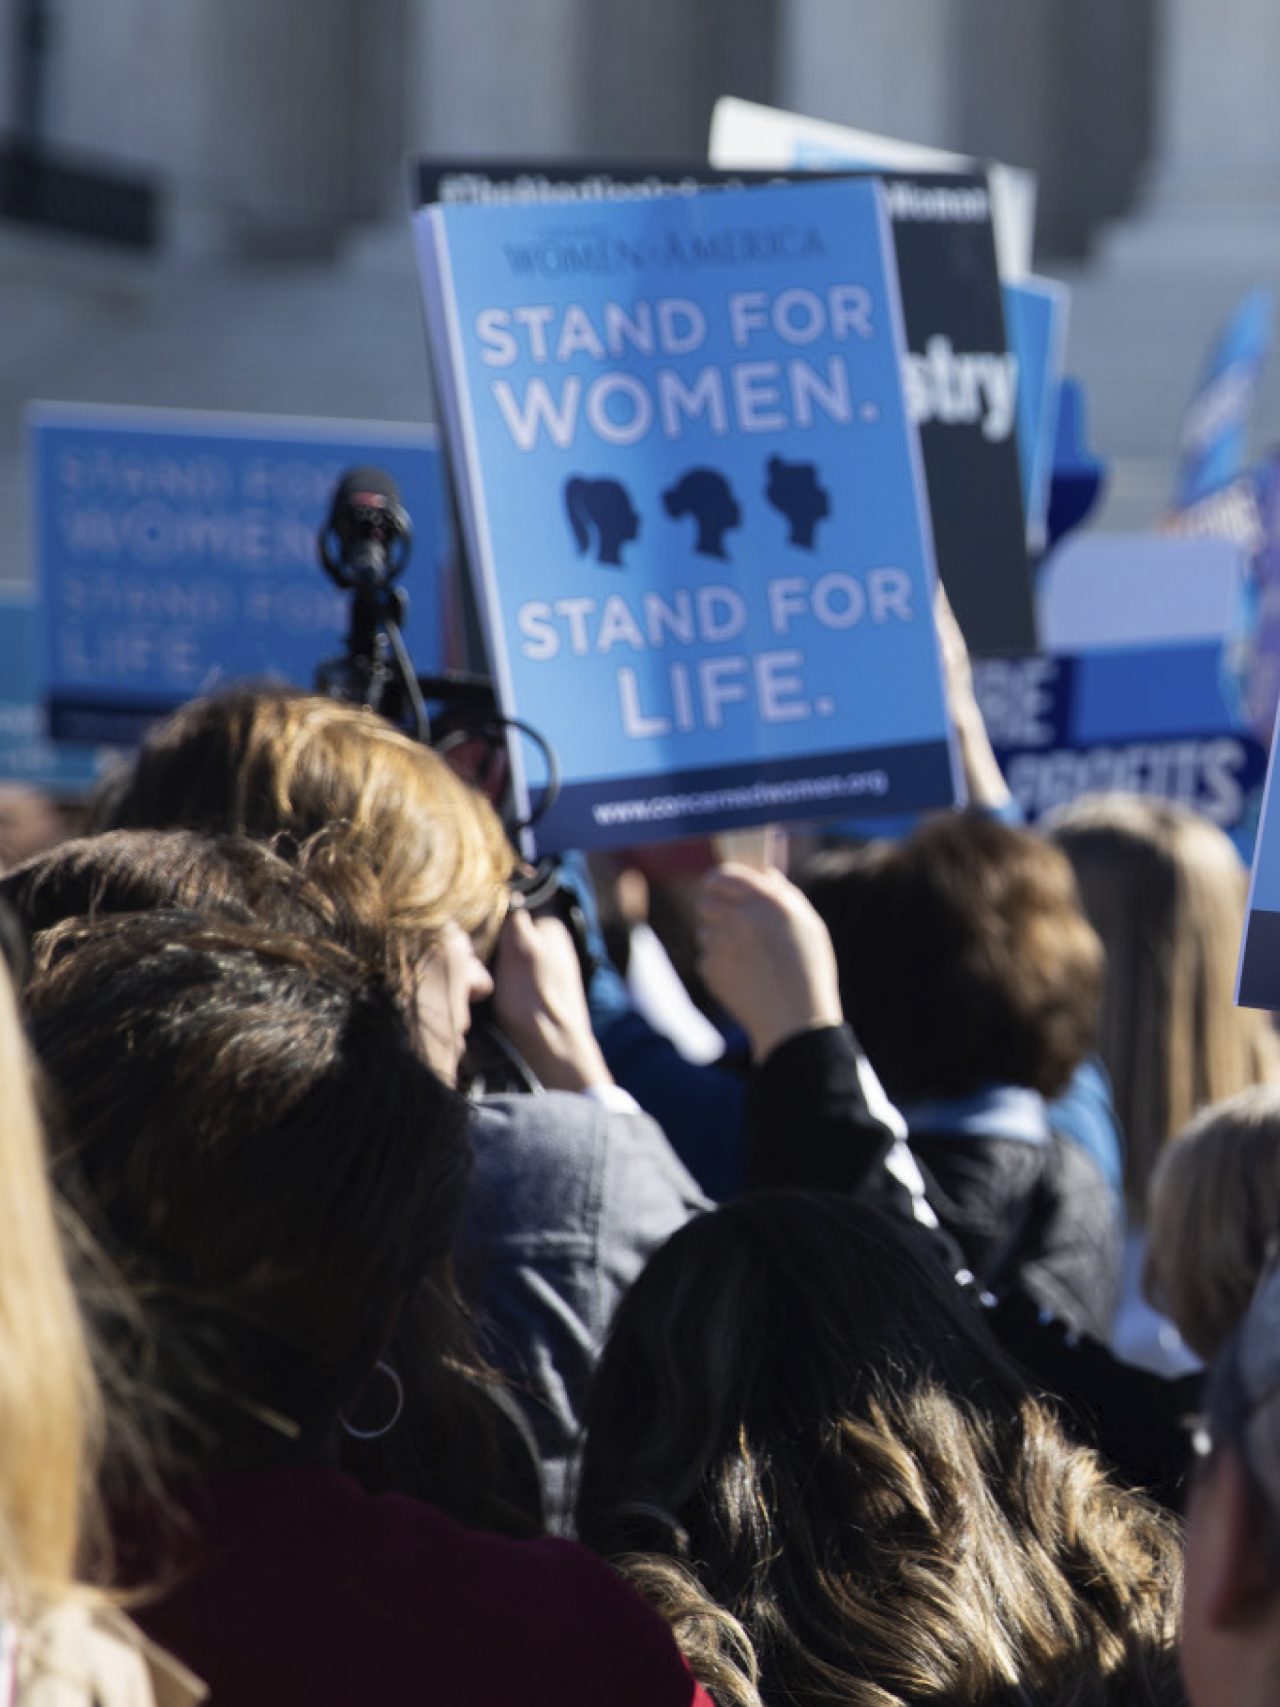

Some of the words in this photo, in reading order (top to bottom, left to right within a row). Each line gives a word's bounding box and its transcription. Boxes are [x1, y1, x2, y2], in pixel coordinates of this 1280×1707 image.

[503, 237, 645, 279] WOMEN
[665, 223, 828, 269] AMERICA
[475, 299, 703, 366] STAND
[728, 284, 875, 350] FOR
[493, 357, 880, 452] WOMEN.
[903, 334, 1019, 442] stry
[516, 584, 749, 661] STAND
[767, 565, 915, 634] FOR
[618, 648, 836, 739] LIFE.
